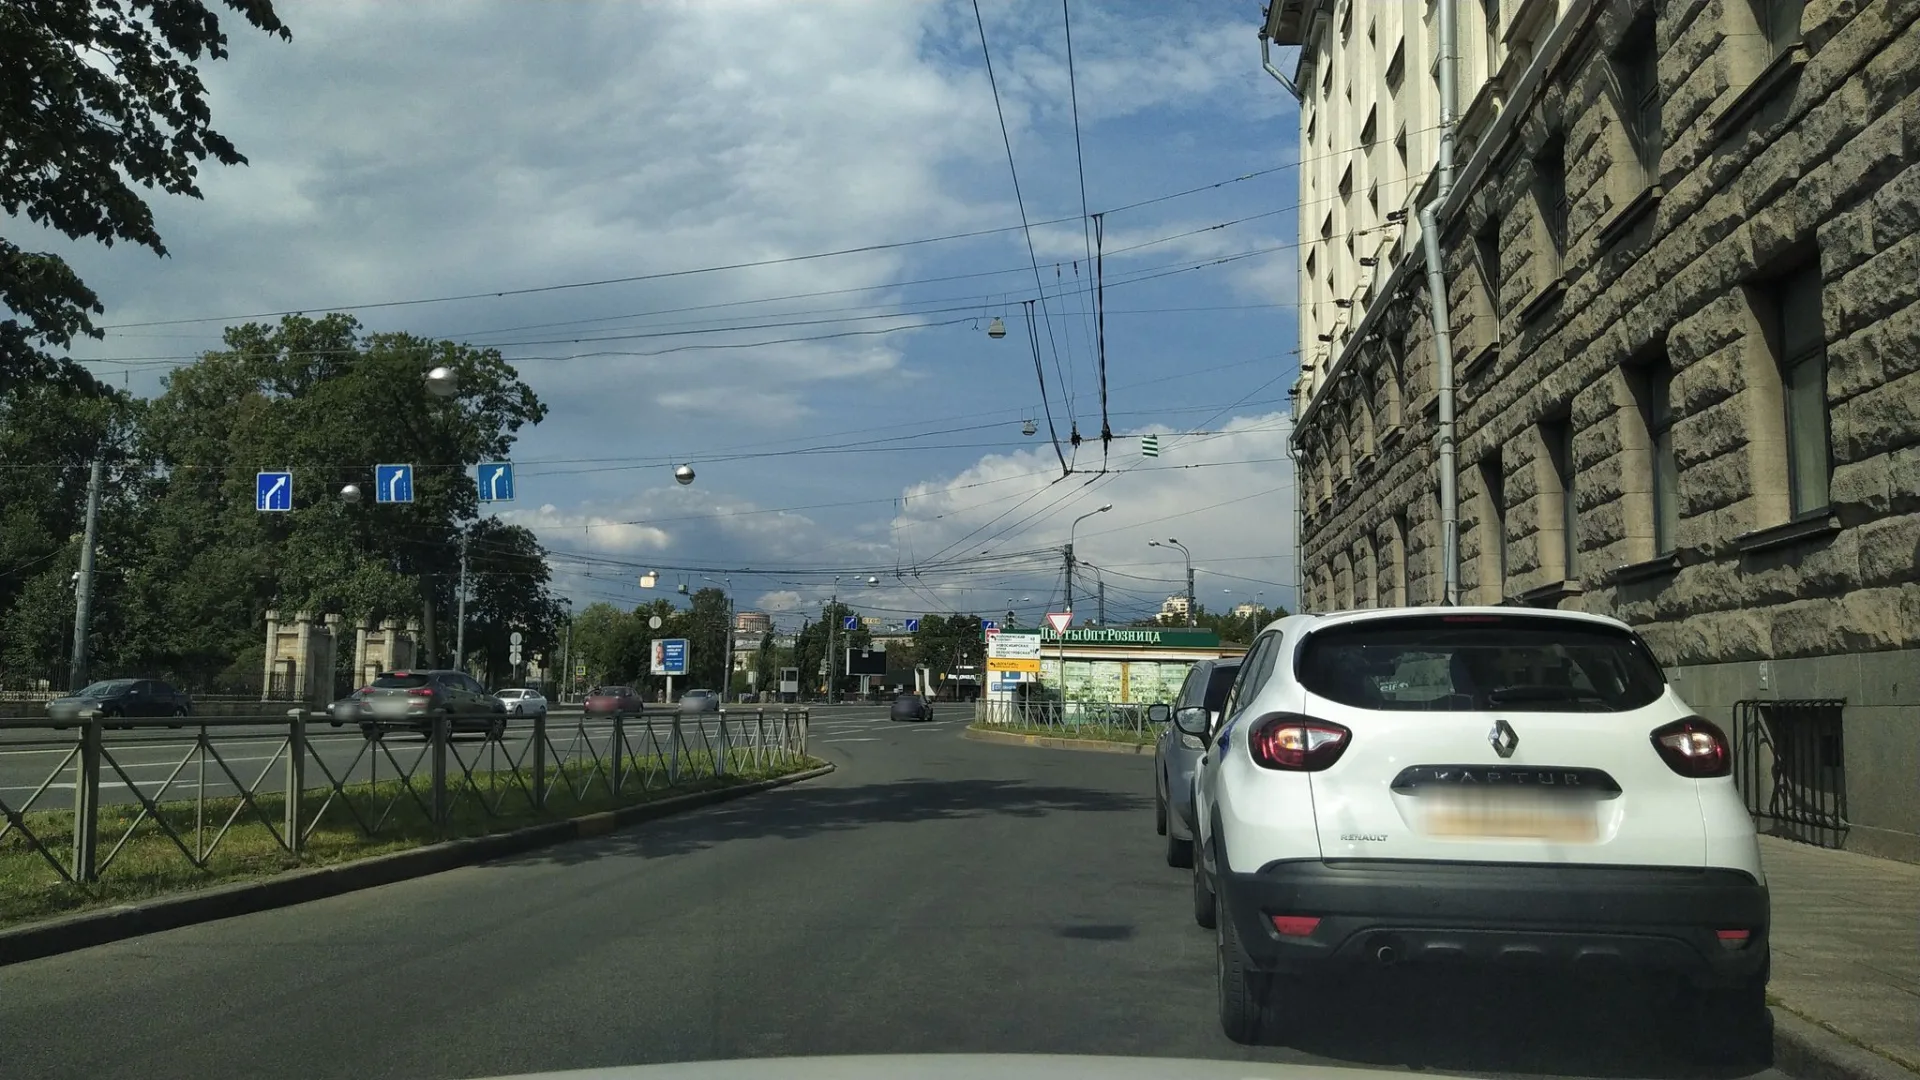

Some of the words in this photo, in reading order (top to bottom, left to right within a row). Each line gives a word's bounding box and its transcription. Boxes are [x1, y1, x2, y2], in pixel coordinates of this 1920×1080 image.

[1107, 628, 1161, 644] РОЗНИЦА
[1435, 771, 1580, 785] KAPTUR
[1340, 833, 1388, 842] RENAULT
